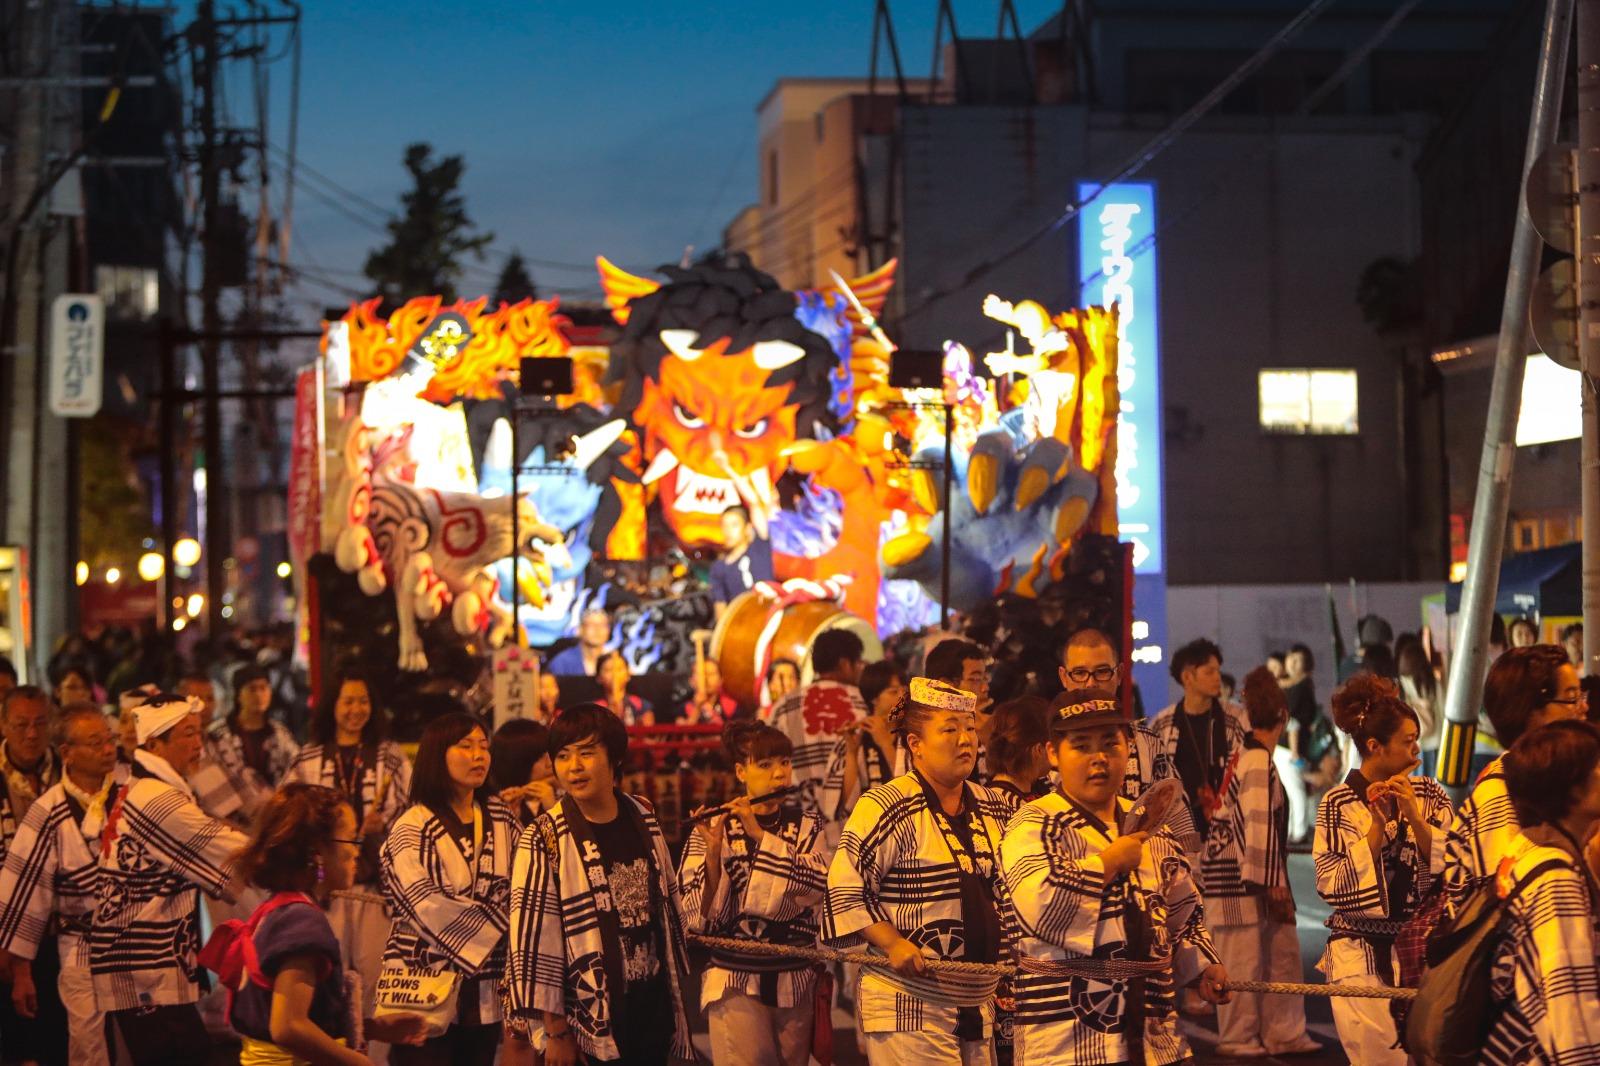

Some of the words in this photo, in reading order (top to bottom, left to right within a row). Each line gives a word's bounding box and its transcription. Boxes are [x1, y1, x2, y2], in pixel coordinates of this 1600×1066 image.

[1059, 699, 1117, 719] HONEY
[407, 966, 443, 978] WIND
[378, 978, 421, 991] BLOWS
[391, 992, 425, 1004] WILL.
